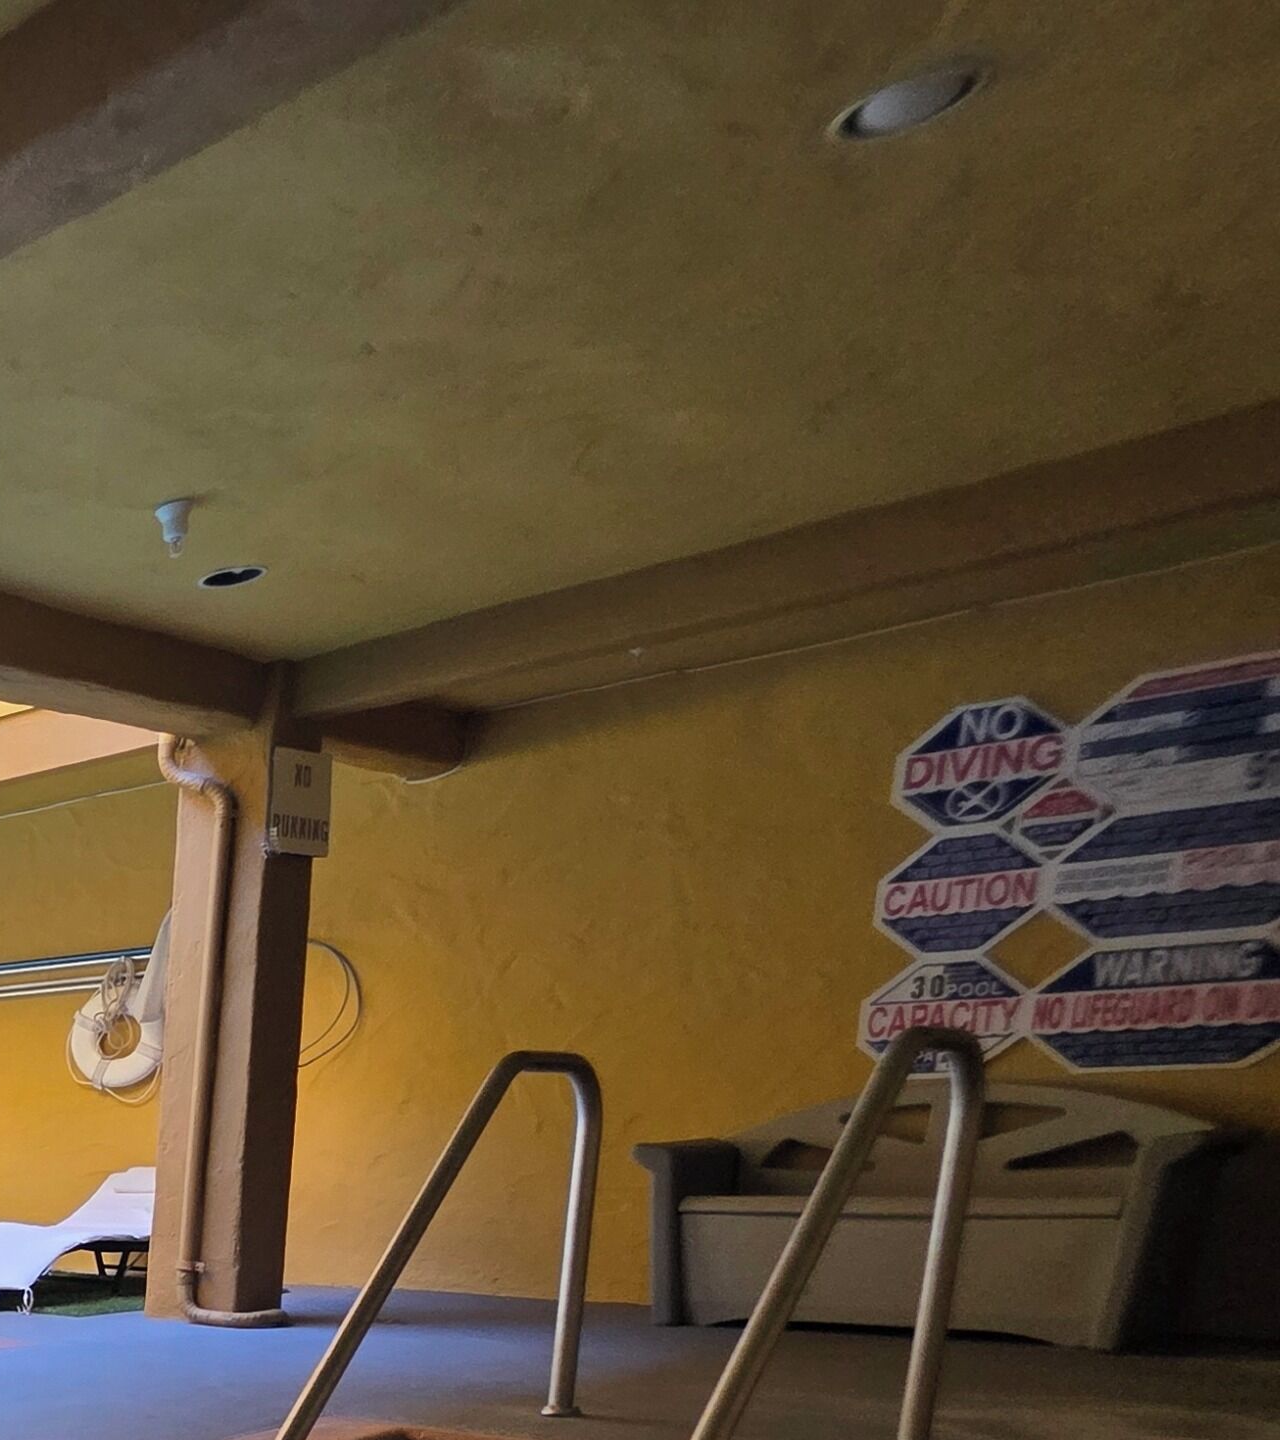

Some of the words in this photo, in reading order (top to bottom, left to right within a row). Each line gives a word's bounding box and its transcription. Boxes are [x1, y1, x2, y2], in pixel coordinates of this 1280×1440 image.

[957, 703, 1026, 745] NO
[903, 735, 1065, 790] DIVING
[883, 871, 1037, 917] CAUTION
[1095, 942, 1263, 988] WARNING
[910, 974, 945, 999] 30
[947, 982, 1005, 998] POOL
[867, 998, 1020, 1039] CAPACITY
[1032, 996, 1065, 1028] NO
